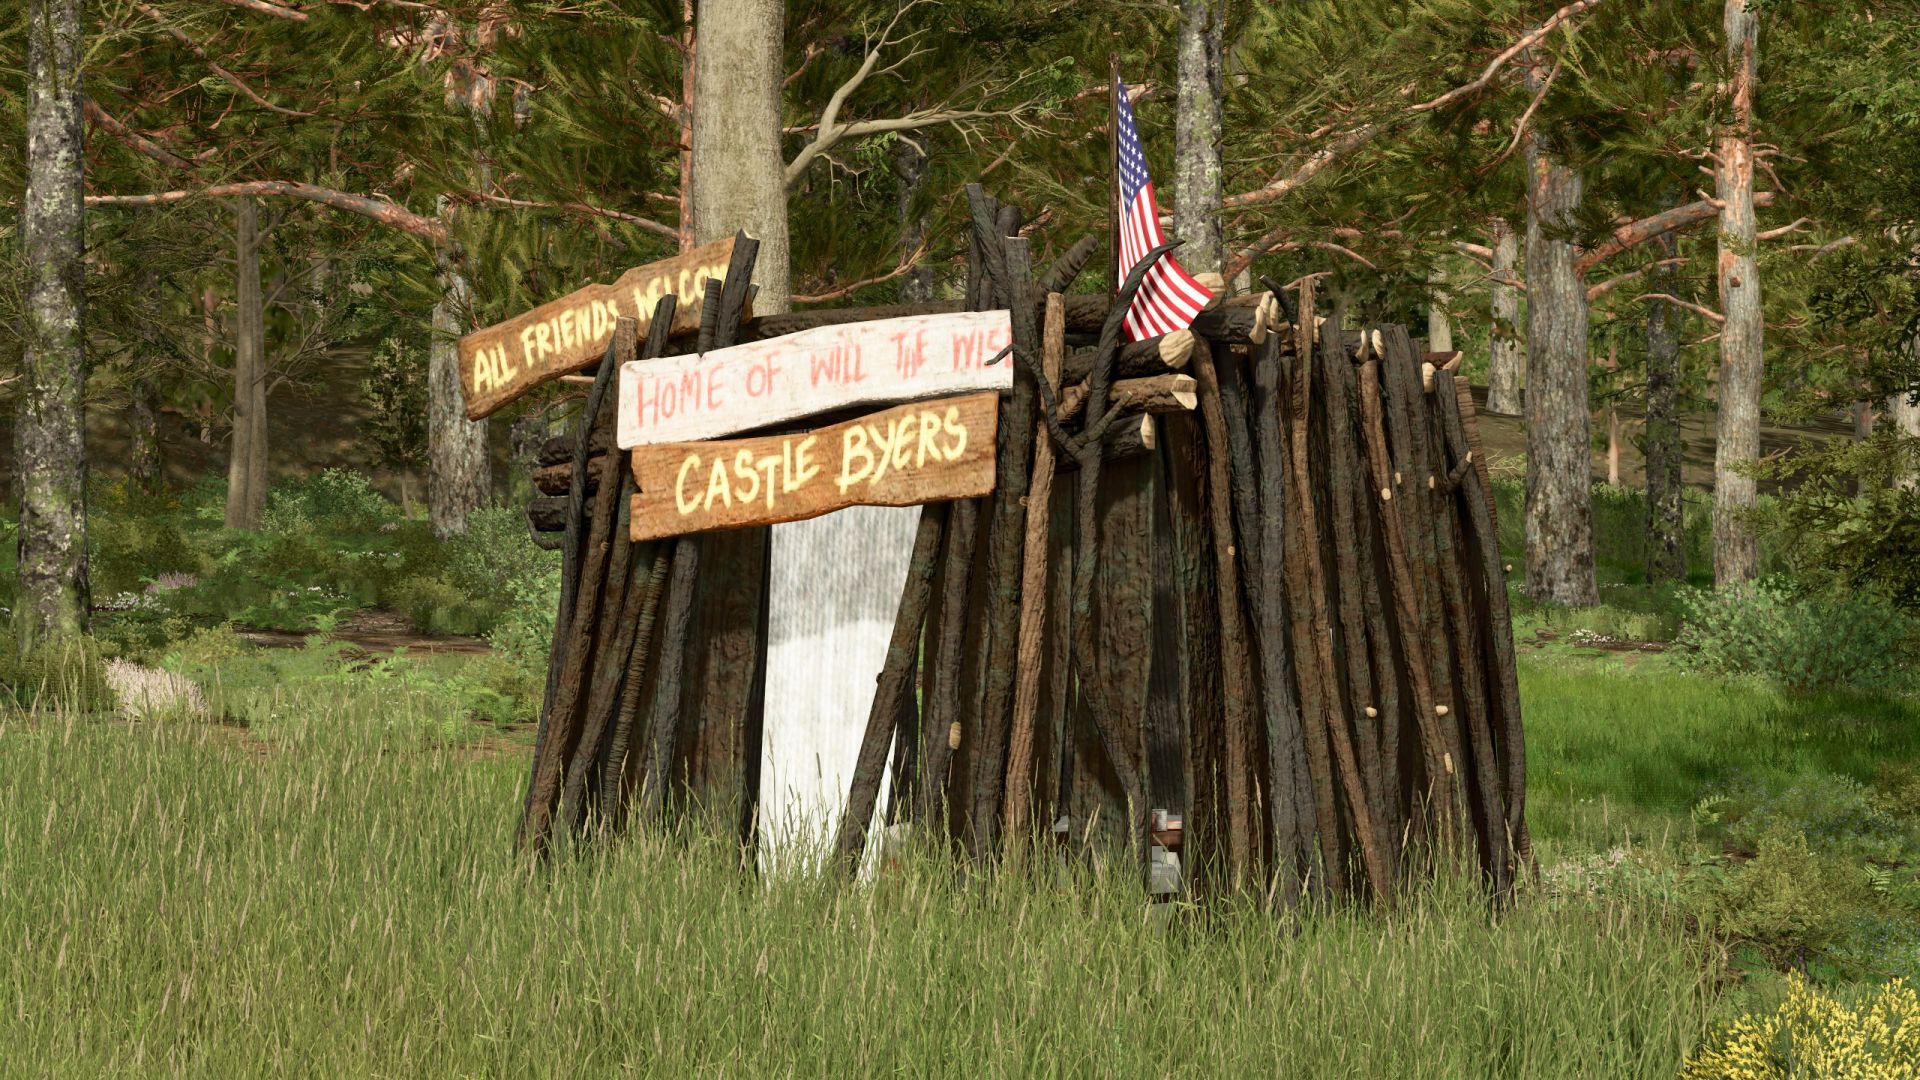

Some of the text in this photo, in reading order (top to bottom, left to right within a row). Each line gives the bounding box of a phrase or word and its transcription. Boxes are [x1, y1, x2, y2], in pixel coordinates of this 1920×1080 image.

[473, 342, 517, 393] ALL
[521, 299, 620, 367] FRIENDS
[637, 363, 724, 427] HOME
[746, 351, 782, 396] OF
[811, 341, 867, 387] WILL
[890, 329, 928, 380] THE
[675, 405, 968, 515] CASTLE BYERS
